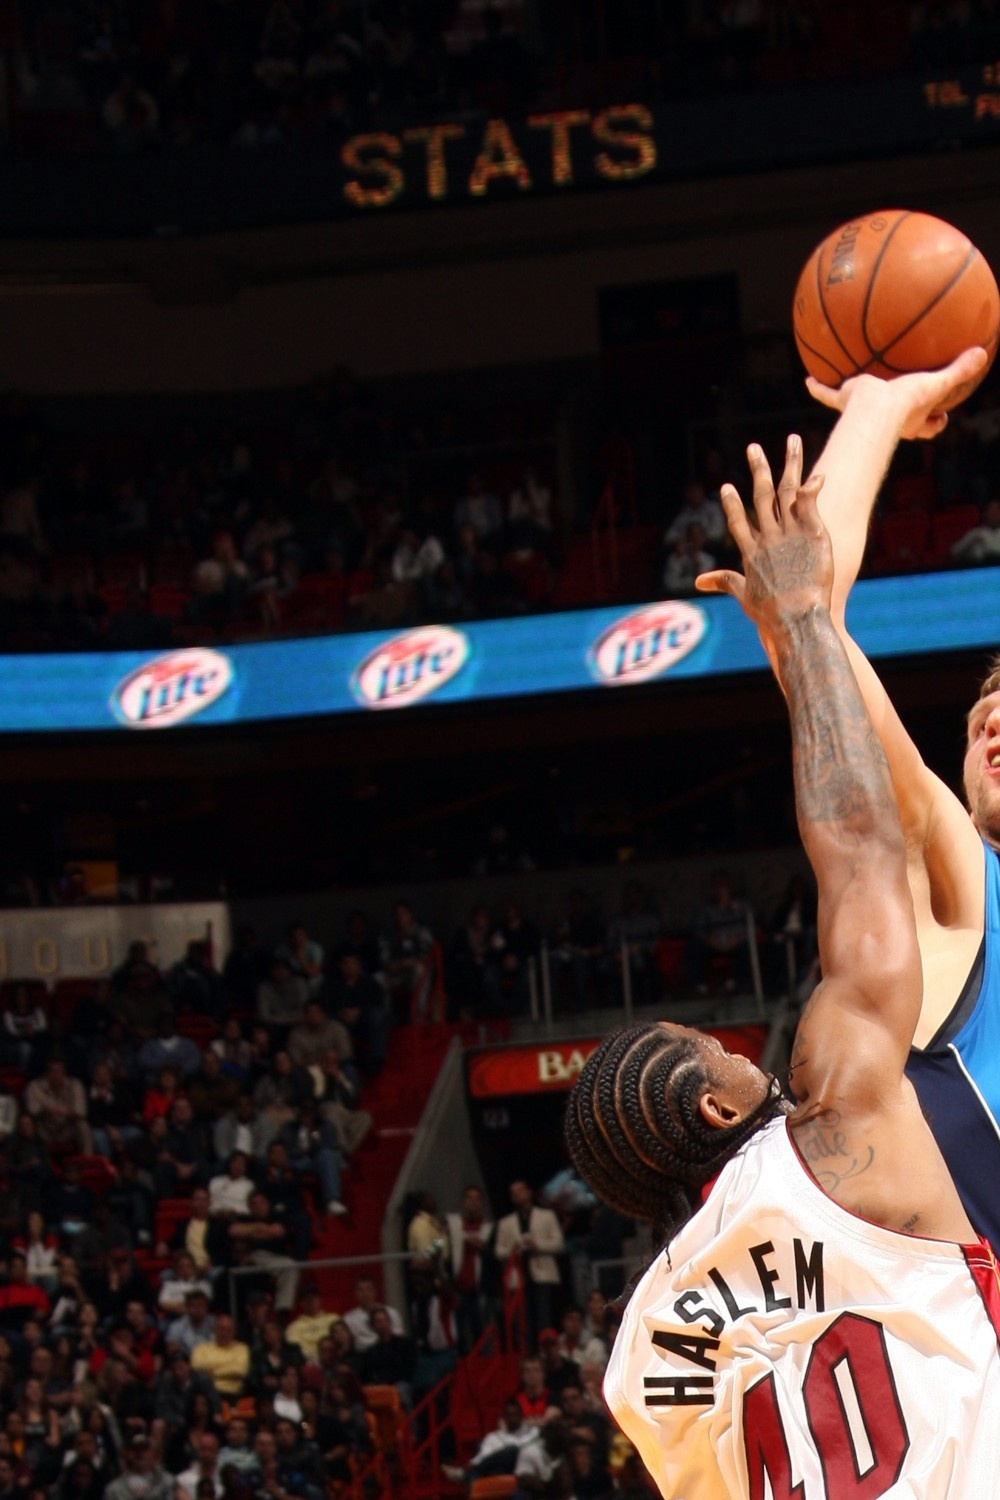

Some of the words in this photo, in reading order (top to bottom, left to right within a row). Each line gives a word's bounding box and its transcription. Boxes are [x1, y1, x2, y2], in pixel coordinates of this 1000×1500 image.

[340, 103, 658, 207] STATS
[376, 646, 454, 701] Lite
[616, 621, 693, 676] Lite
[135, 669, 219, 721] Lite
[643, 1238, 825, 1407] HASLEM
